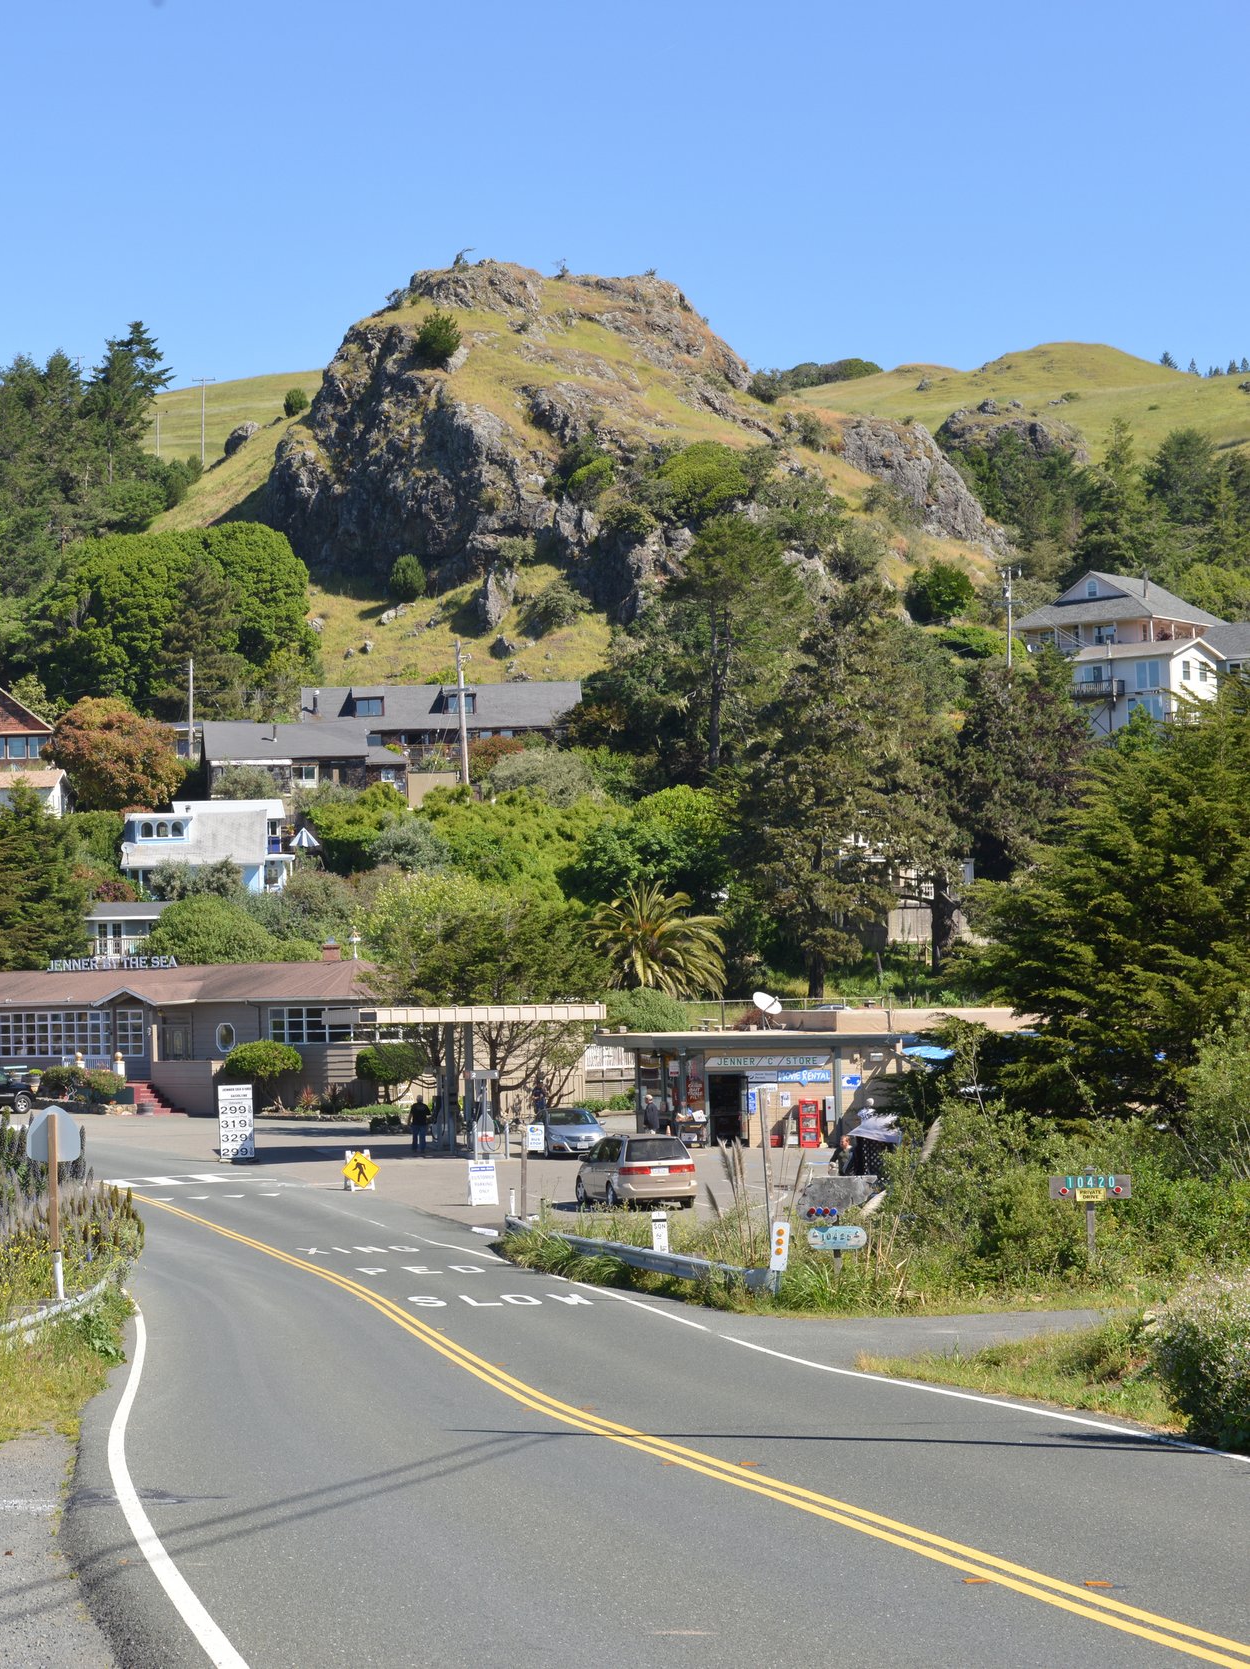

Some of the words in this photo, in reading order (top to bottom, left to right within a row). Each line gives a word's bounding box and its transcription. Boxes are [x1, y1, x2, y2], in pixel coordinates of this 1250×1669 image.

[47, 958, 98, 972] JENNER
[102, 958, 119, 970] BY
[122, 957, 148, 969] THE
[151, 955, 178, 968] SEA
[717, 1057, 755, 1066] JENNER
[786, 1056, 818, 1065] STORE
[779, 1071, 801, 1081] MOVIE
[802, 1069, 831, 1081] RENTAL
[220, 1105, 247, 1115] 299
[221, 1119, 247, 1129] 319
[221, 1133, 248, 1142] 329
[222, 1147, 248, 1157] 299
[1068, 1176, 1115, 1188] 10420
[296, 1245, 420, 1255] XING
[355, 1265, 486, 1275] PED
[407, 1293, 594, 1307] SLOW
